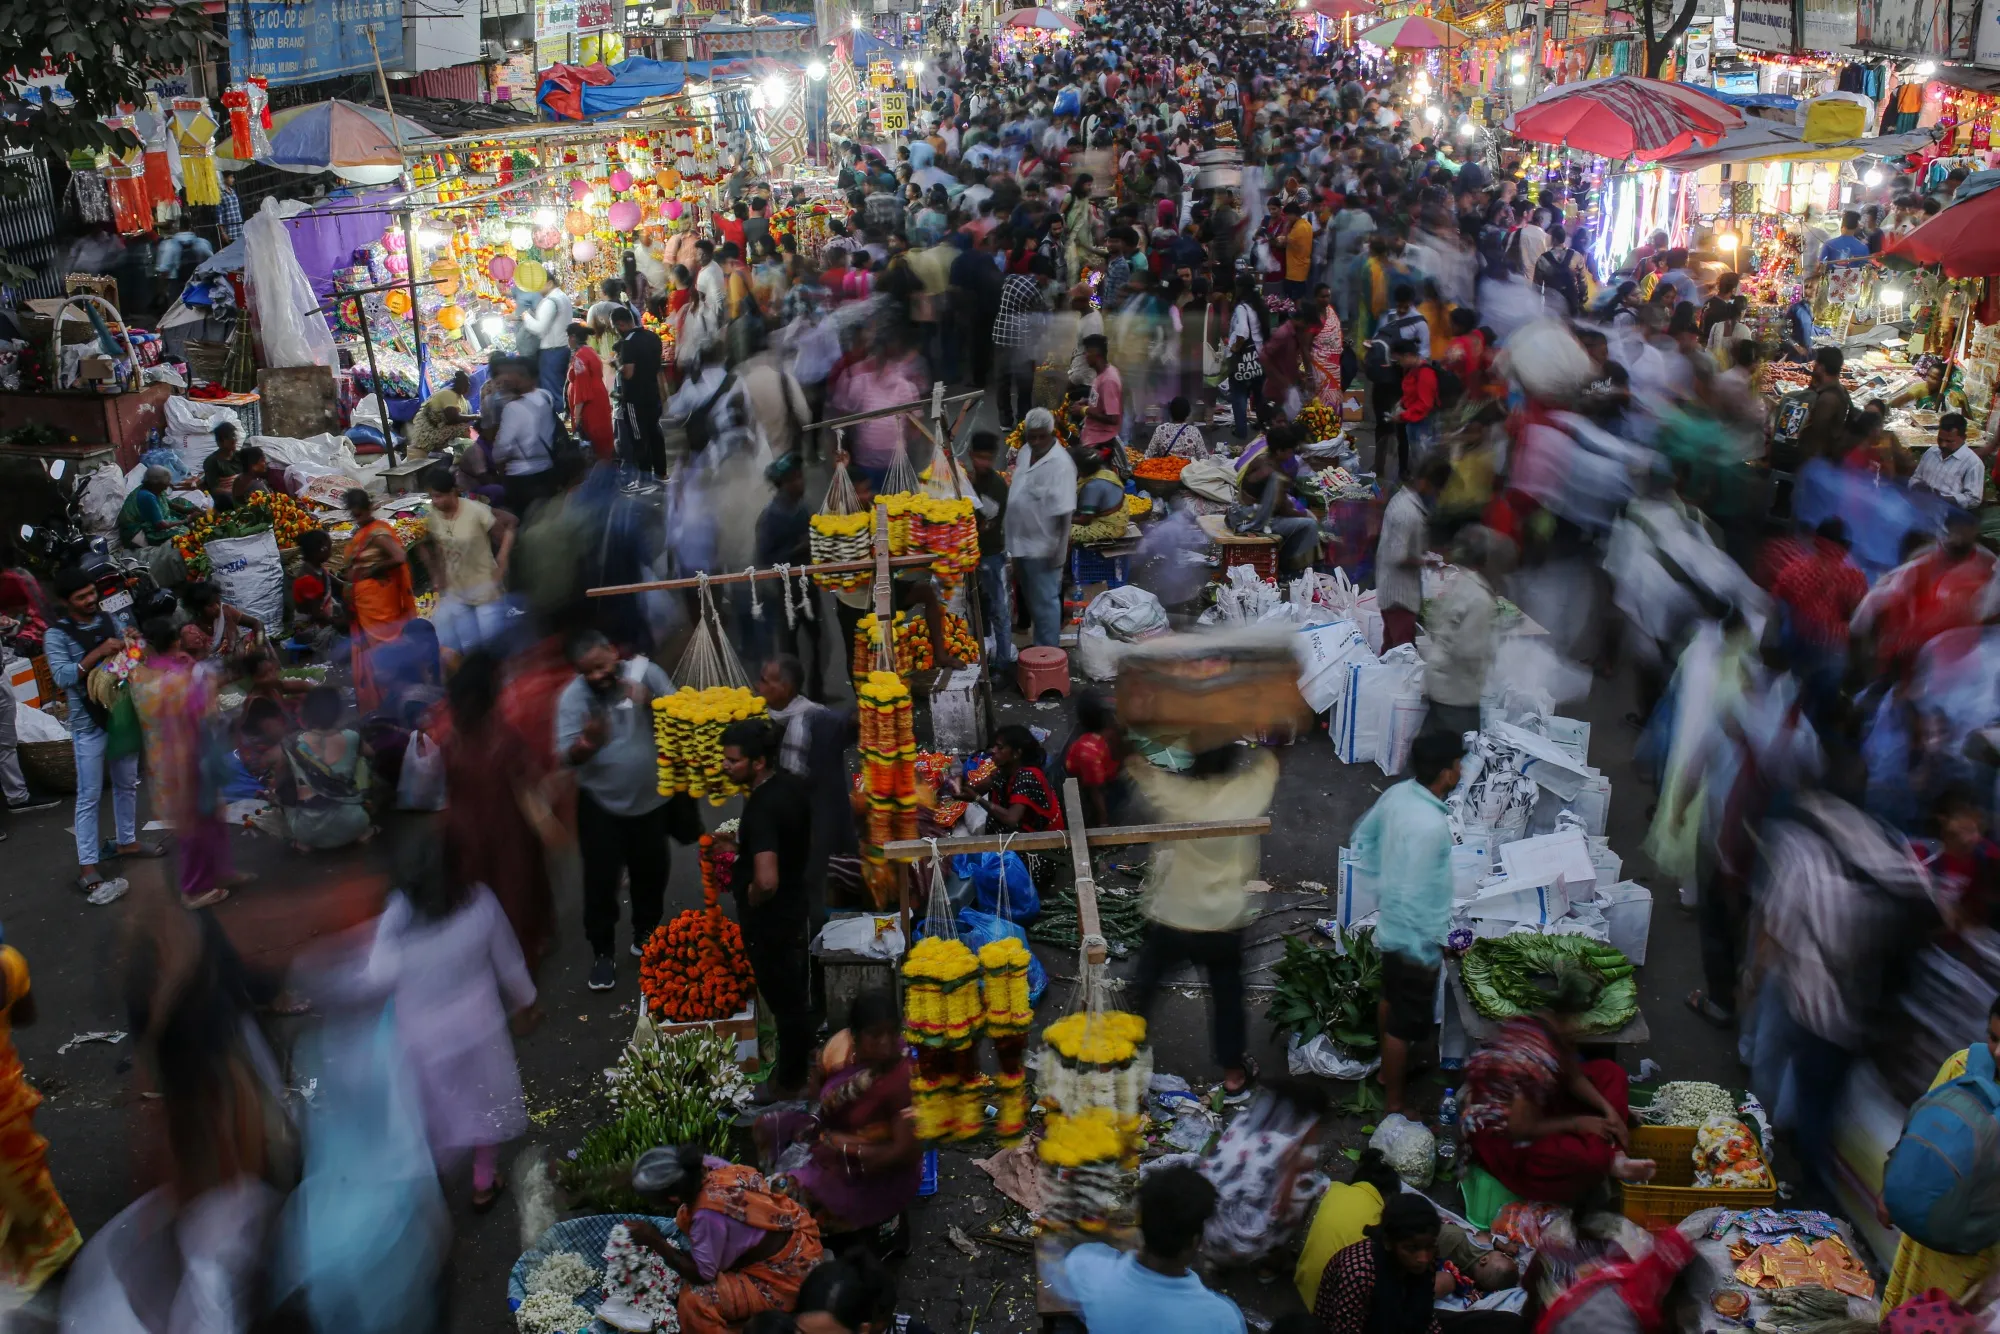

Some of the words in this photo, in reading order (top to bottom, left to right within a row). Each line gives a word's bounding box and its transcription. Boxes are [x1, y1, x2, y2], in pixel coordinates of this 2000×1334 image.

[886, 97, 902, 110] 50
[887, 115, 903, 128] 50
[1242, 350, 1260, 363] MA
[1237, 360, 1261, 372] RAN
